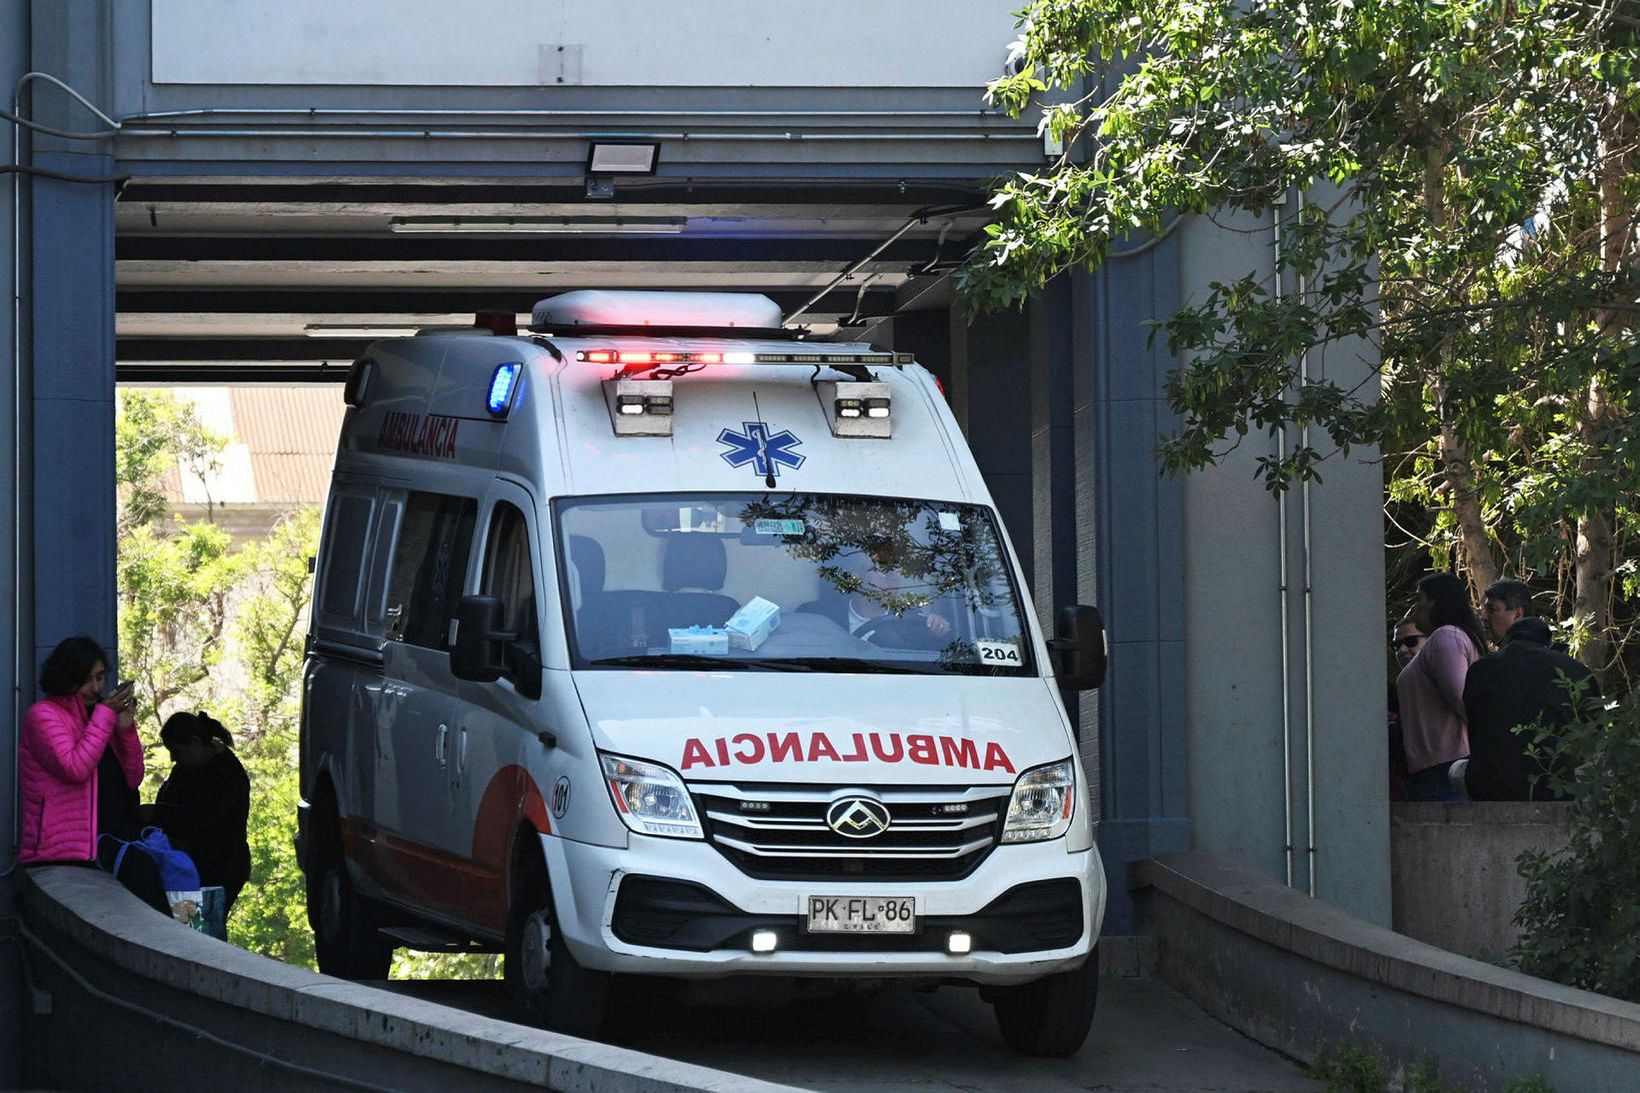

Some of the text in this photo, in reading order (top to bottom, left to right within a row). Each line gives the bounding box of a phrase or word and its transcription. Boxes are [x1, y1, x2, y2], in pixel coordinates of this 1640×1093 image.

[379, 412, 459, 458] AMBULANCIA
[981, 647, 1018, 661] 204
[553, 784, 569, 812] 101
